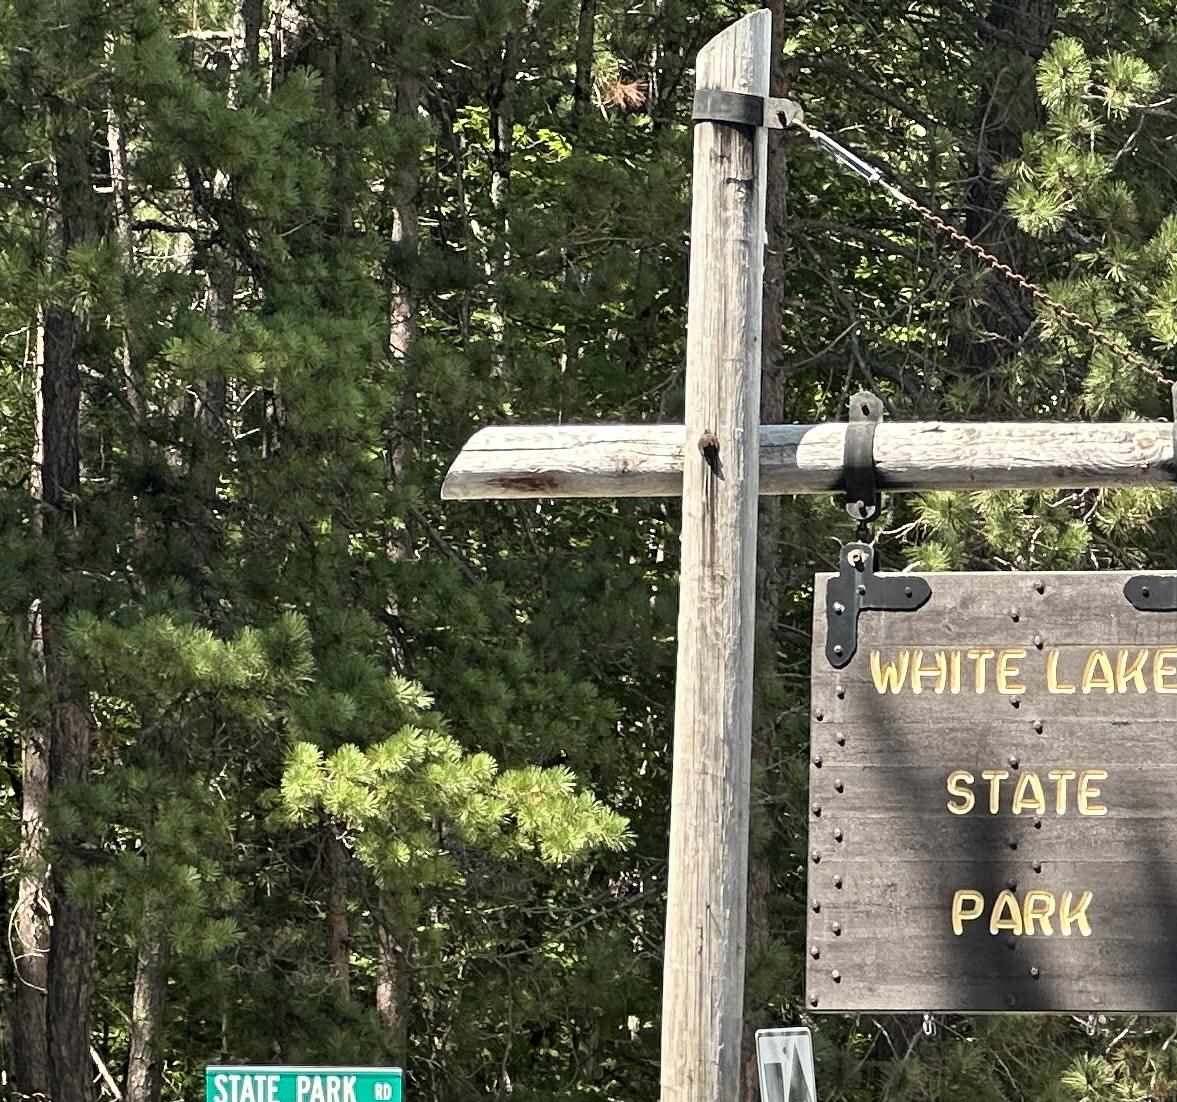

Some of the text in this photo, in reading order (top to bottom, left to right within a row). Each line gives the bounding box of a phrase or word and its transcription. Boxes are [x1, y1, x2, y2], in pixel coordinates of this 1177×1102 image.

[870, 647, 1027, 695] WHITE
[945, 769, 1109, 816] STATE
[951, 889, 1093, 937] PARK
[373, 1081, 393, 1101] RD
